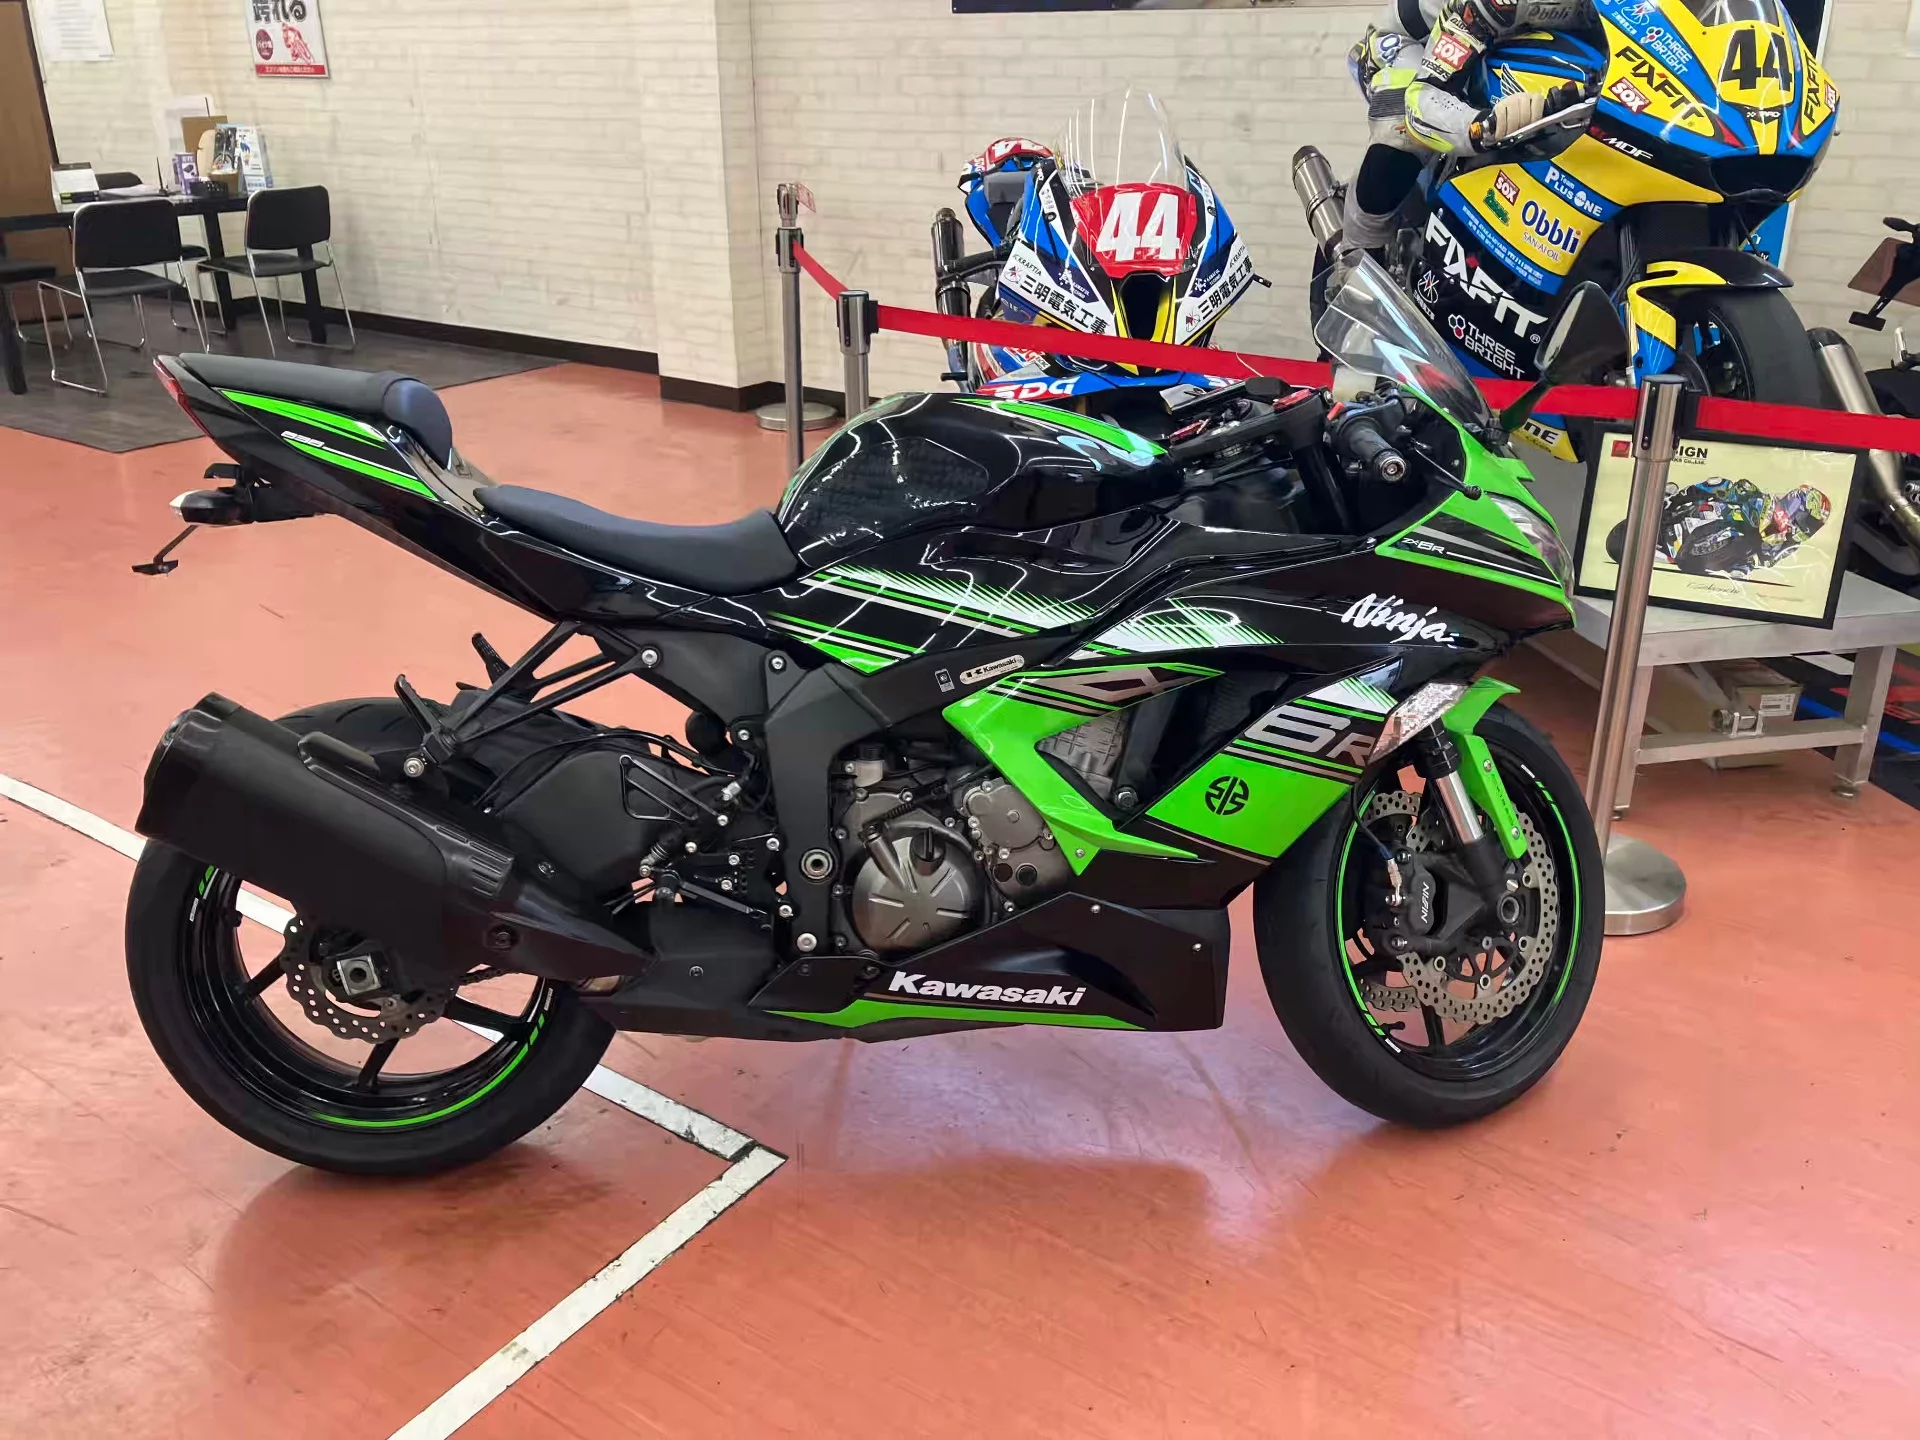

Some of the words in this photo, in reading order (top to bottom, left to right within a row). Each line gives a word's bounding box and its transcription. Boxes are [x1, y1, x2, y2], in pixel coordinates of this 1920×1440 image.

[1434, 40, 1465, 67] SOX
[1651, 40, 1688, 75] BRIGHT
[1662, 32, 1692, 64] THREE
[1721, 29, 1792, 92] 44
[1611, 82, 1645, 113] SOX
[1495, 176, 1517, 204] SOX
[1095, 192, 1180, 262] 44
[1521, 200, 1582, 254] Obbli
[1019, 274, 1108, 334] 三明電気工事
[1464, 335, 1525, 379] BRIGHT
[1468, 321, 1515, 364] THREE
[1675, 445, 1708, 458] IGN
[1340, 593, 1456, 645] Ninja
[983, 658, 1017, 673] Kawasaki
[888, 971, 1087, 1007] Kawasaki
